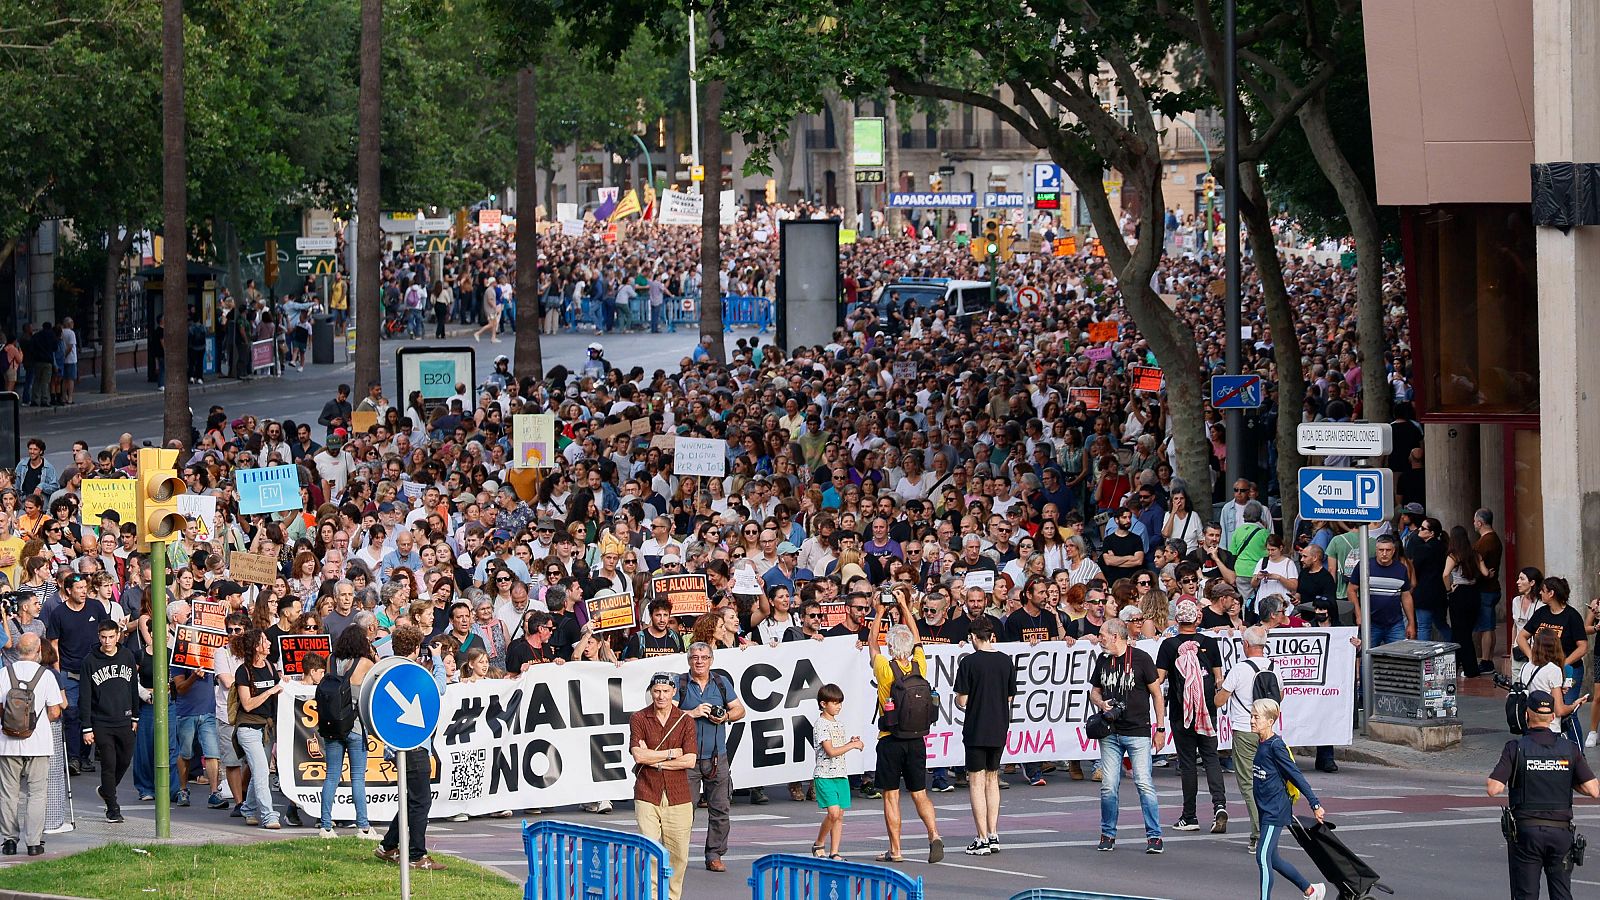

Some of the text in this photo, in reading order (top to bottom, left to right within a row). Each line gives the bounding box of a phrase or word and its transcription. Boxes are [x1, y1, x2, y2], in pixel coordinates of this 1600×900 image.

[1036, 164, 1054, 187] P
[893, 195, 974, 206] APARCAMENT
[998, 195, 1027, 207] ENTR
[424, 373, 451, 385] B20
[1338, 430, 1359, 441] GENERAL
[1359, 430, 1380, 442] CONSELL
[677, 463, 691, 471] PER
[262, 487, 279, 499] ETV
[1317, 477, 1376, 505] 250 m P
[91, 502, 137, 510] VACACIONE
[1350, 507, 1368, 515] ESPAÑA
[655, 578, 705, 593] SE ALQUILA
[195, 603, 202, 611] SE
[588, 595, 631, 612] SE ALQUILA
[828, 605, 846, 614] ALQUI
[178, 628, 229, 647] SE VENDE
[1024, 633, 1036, 641] NO
[282, 638, 329, 650] SE VENDE
[1276, 638, 1323, 655] LLOGA
[1290, 657, 1301, 666] no
[1303, 655, 1316, 666] ho
[1010, 650, 1098, 686] EGUEN
[1290, 668, 1317, 680] pagar
[91, 664, 119, 686] NIKE
[1283, 686, 1340, 697] noesven.com
[443, 658, 825, 746] #MALLCA
[1009, 689, 1098, 724] EGUEN
[301, 699, 319, 729] S
[923, 731, 954, 760] ET
[1005, 728, 1056, 756] UNA
[489, 738, 563, 795] NO
[589, 732, 628, 783] E
